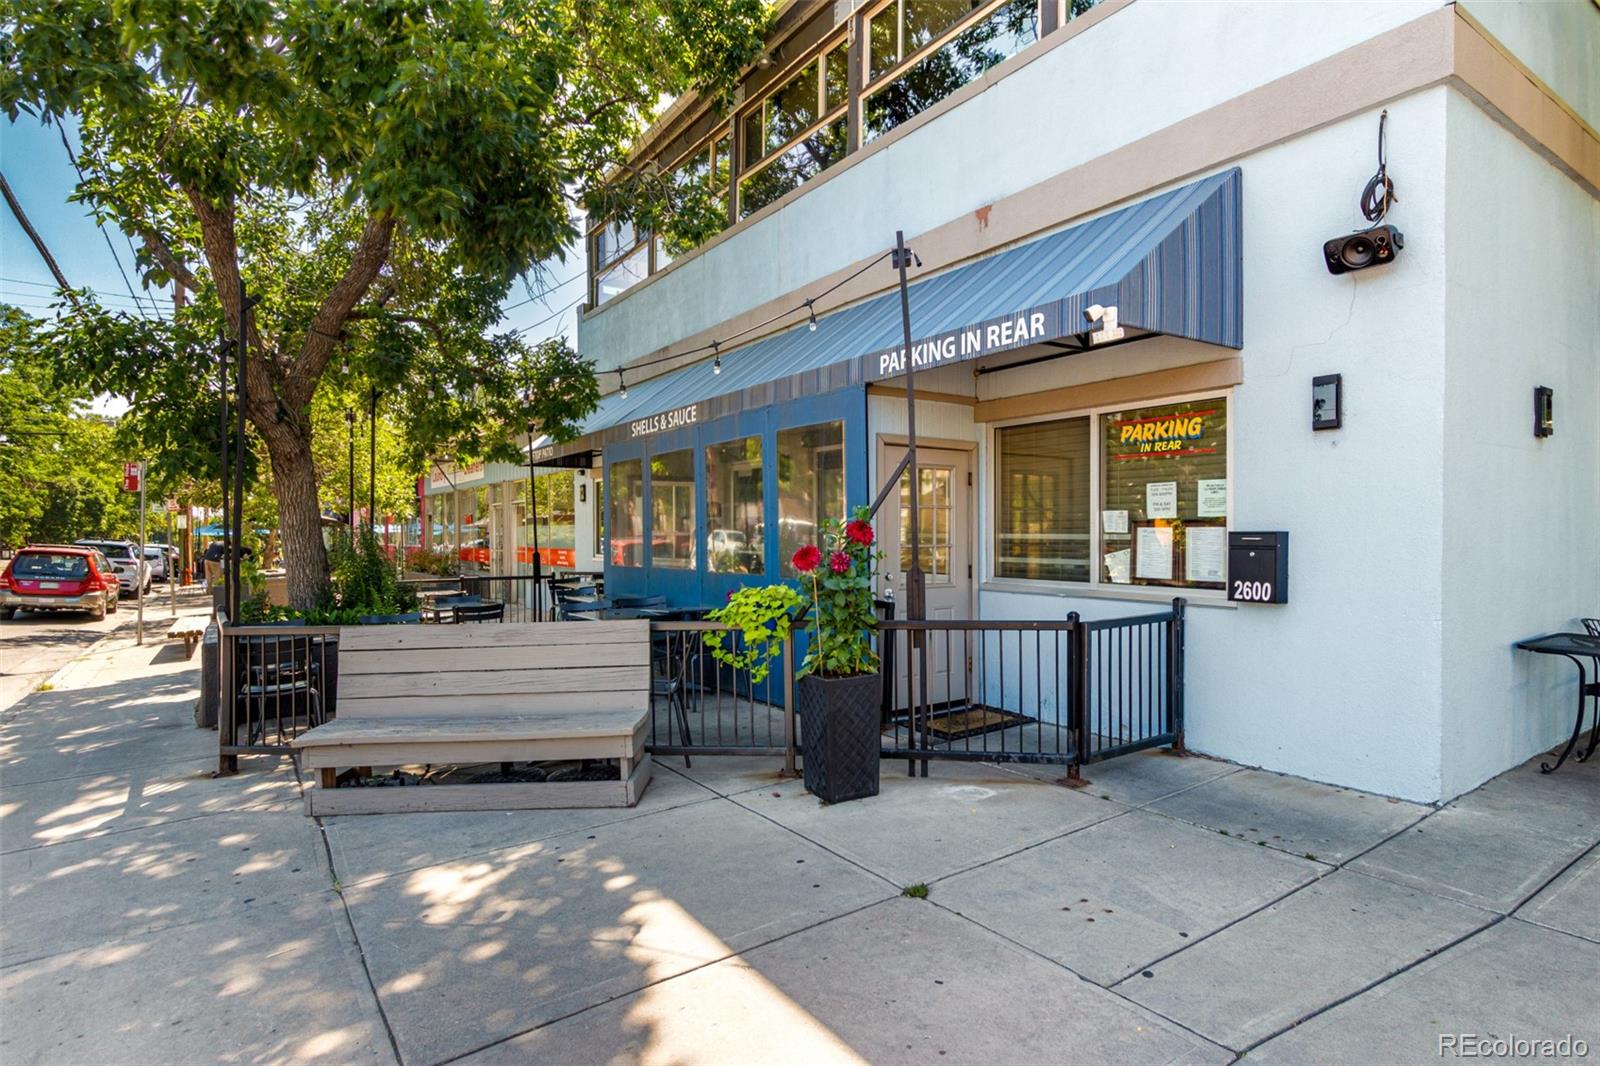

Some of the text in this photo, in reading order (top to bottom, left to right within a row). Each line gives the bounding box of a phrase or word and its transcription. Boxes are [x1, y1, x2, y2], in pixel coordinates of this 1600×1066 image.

[960, 328, 981, 355] IN
[987, 312, 1045, 349] REAR
[631, 405, 697, 437] SHELLS & SAUCE
[1120, 416, 1202, 443] PARKING
[1140, 440, 1182, 453] IN REAR
[1233, 580, 1272, 601] 2600
